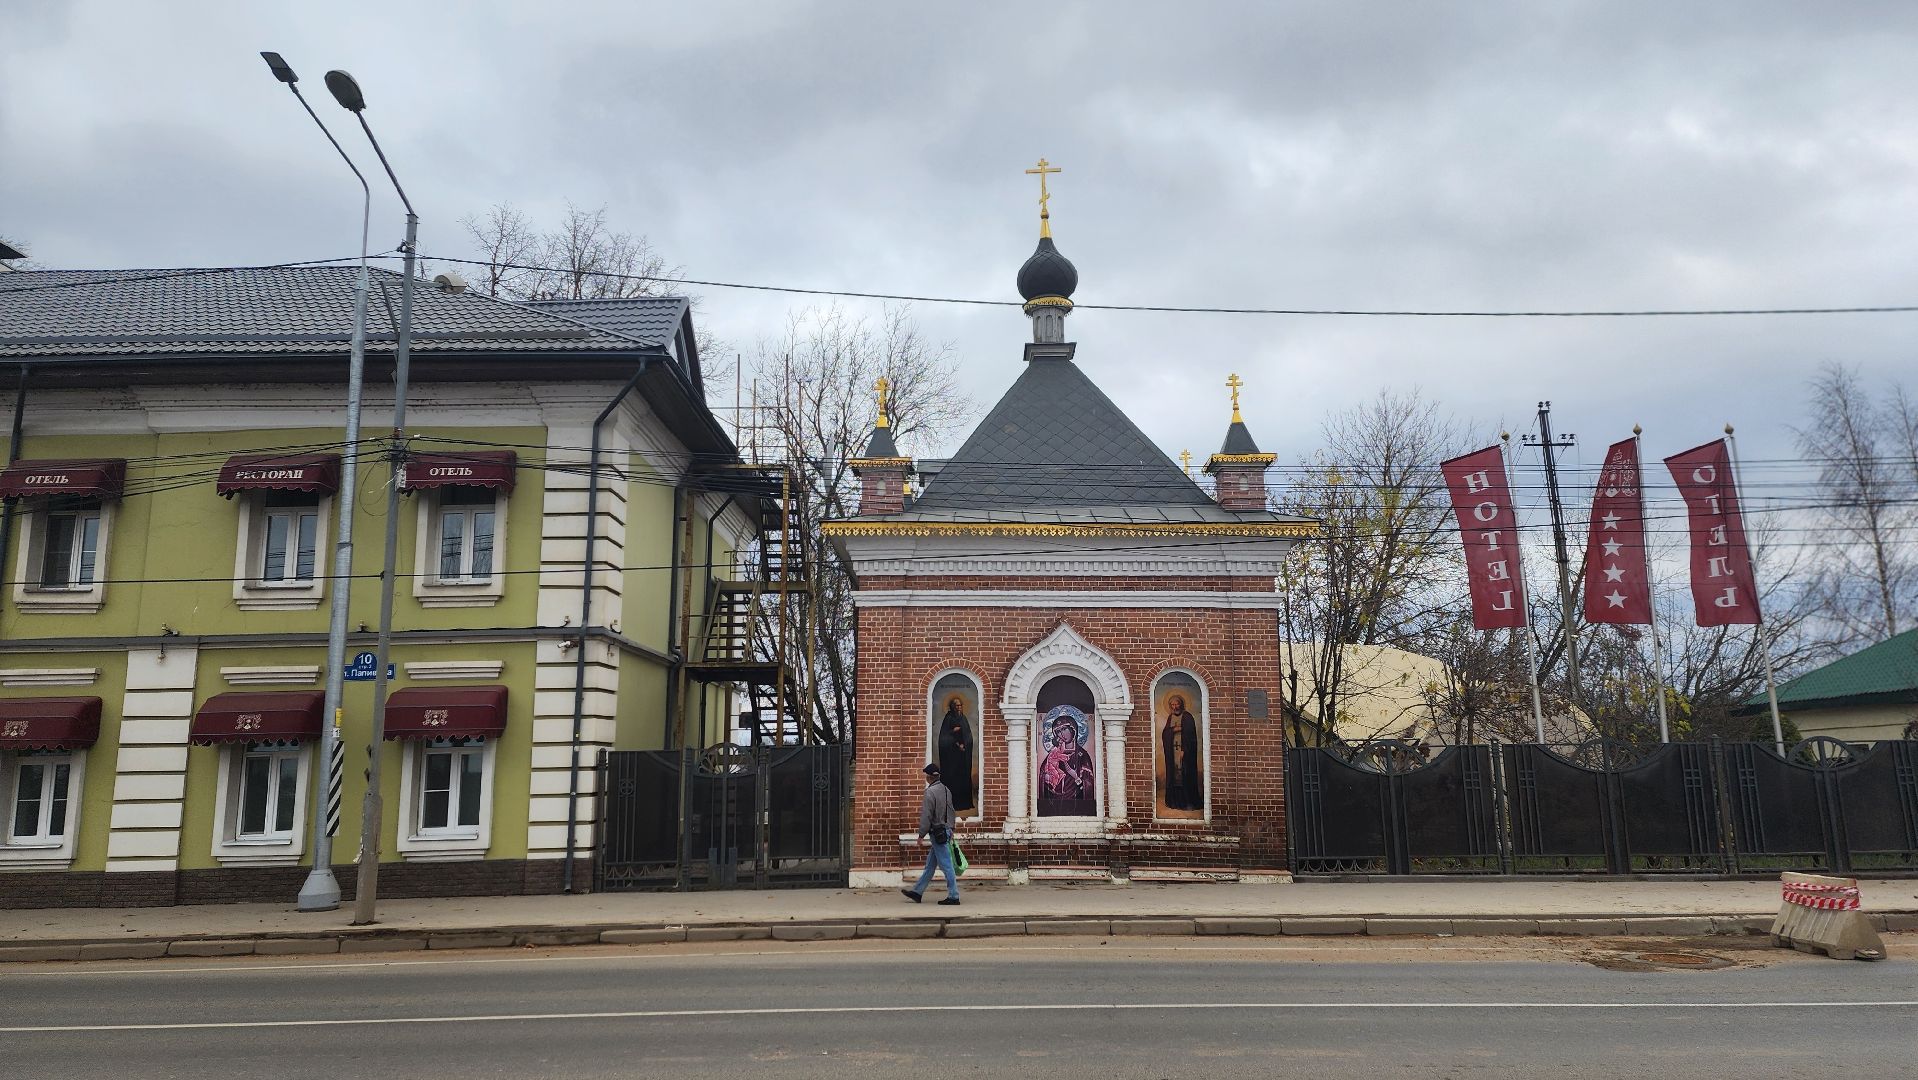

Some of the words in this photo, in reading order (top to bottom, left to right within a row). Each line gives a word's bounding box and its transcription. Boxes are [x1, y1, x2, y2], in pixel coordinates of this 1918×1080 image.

[428, 467, 473, 476] ОТЕЛЬ
[24, 475, 69, 484] ОТЕЛЬ
[358, 654, 372, 665] 10
[351, 669, 392, 677] Папива
